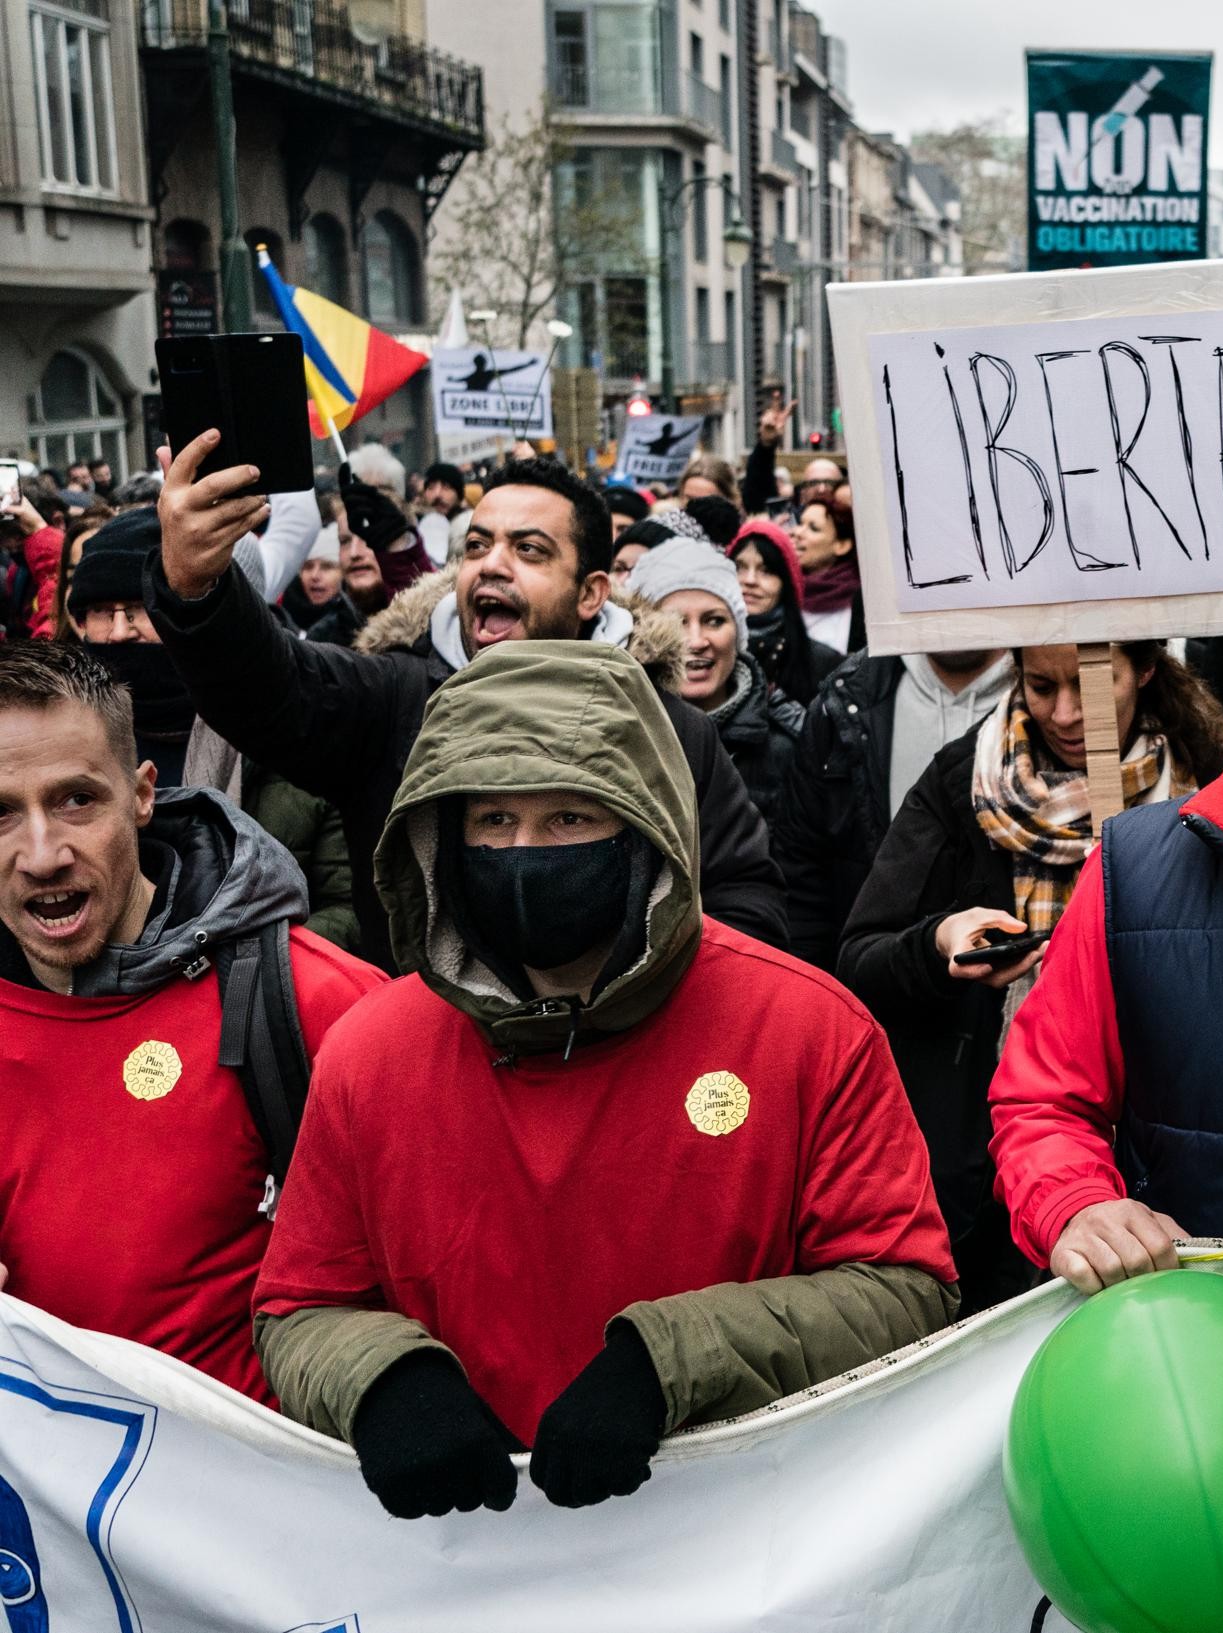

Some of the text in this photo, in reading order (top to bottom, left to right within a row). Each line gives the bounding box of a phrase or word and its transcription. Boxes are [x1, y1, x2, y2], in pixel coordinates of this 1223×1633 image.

[1034, 111, 1203, 192] NON
[1036, 196, 1199, 223] VACCINATION
[1036, 225, 1198, 252] OBLIGATOIRE
[450, 398, 488, 411] ZONE
[146, 1055, 164, 1067] Plus
[138, 1064, 165, 1077] jamais
[708, 1089, 729, 1099] Plus
[704, 1098, 734, 1111] jamais
